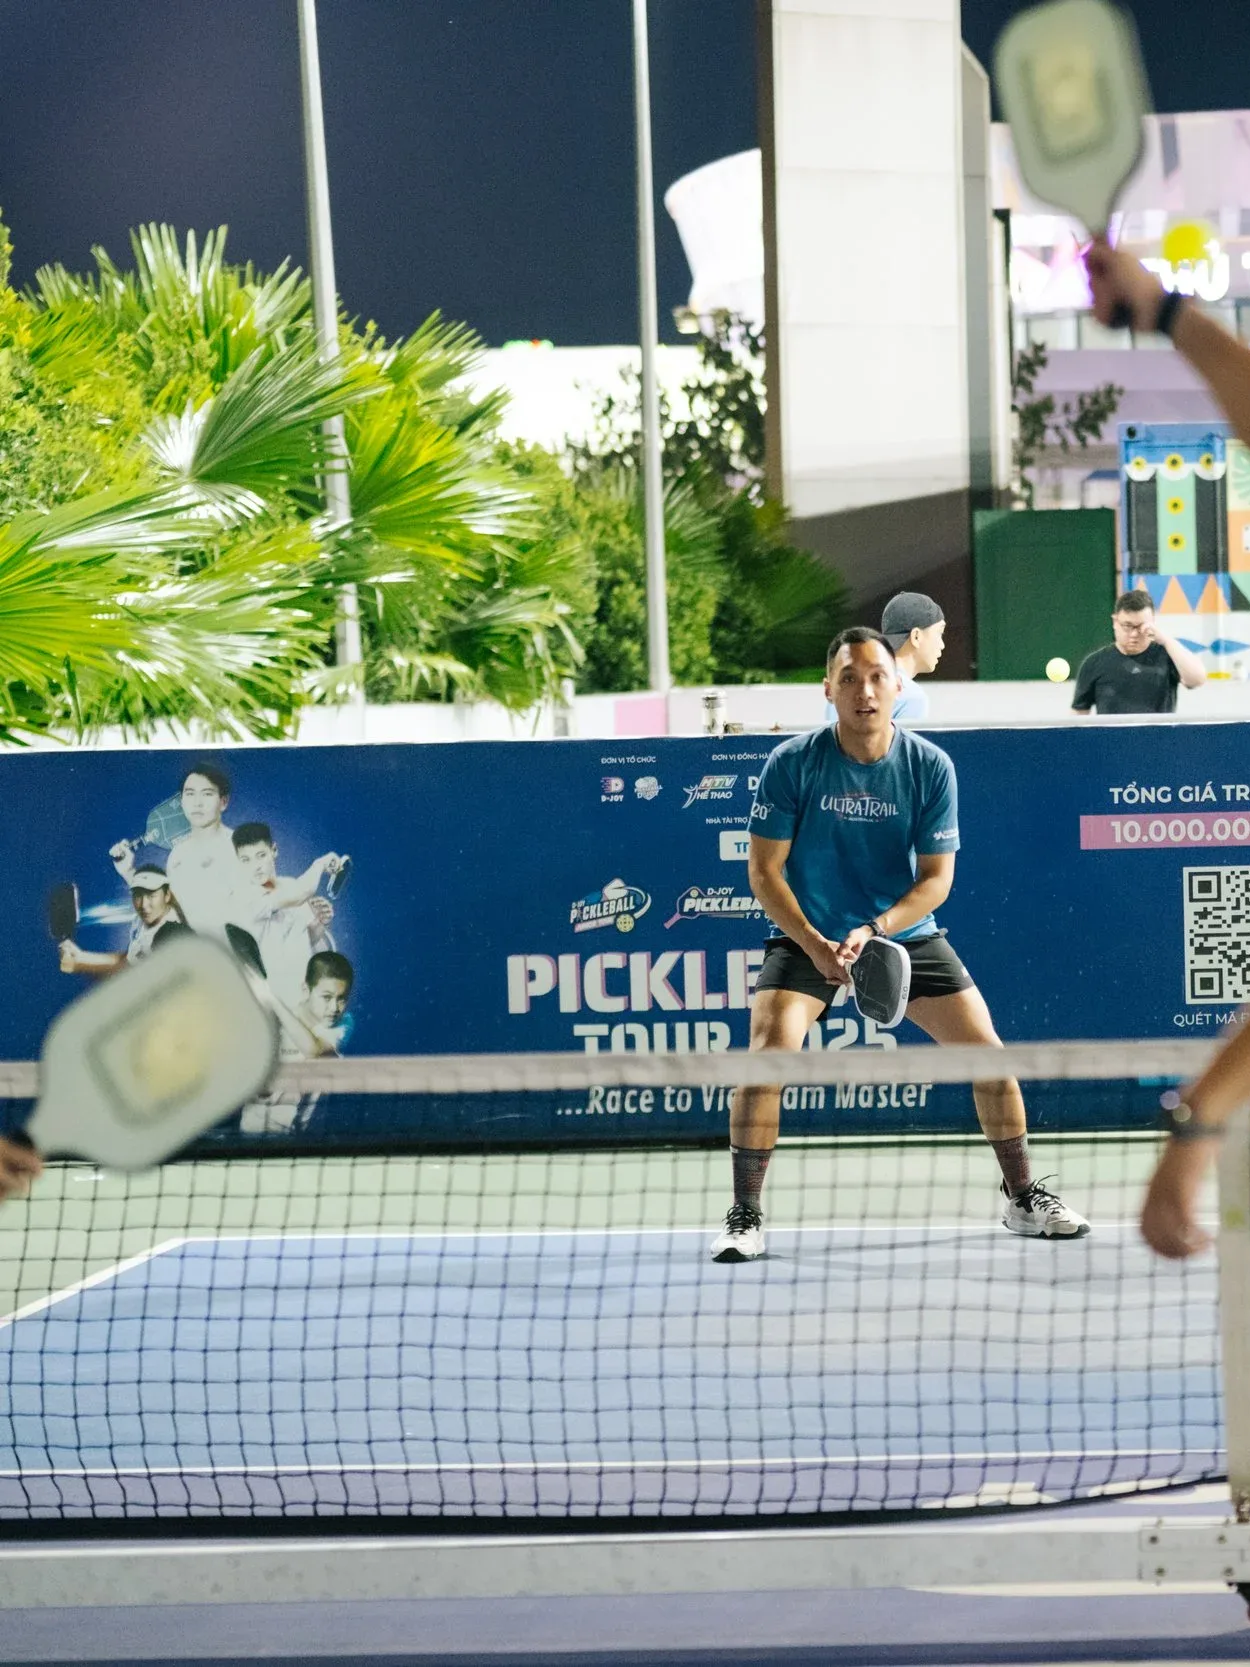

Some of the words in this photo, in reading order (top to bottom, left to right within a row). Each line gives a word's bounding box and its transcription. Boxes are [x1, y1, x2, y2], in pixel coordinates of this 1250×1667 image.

[700, 776, 736, 788] HTV
[601, 794, 624, 802] D-JOY
[1109, 781, 1172, 805] TỔNG
[1178, 781, 1216, 803] GIÁ
[707, 887, 734, 895] D-JOY
[683, 896, 763, 912] PICKLEBA
[1173, 1011, 1212, 1027] QUÉT
[1216, 1010, 1238, 1024] MÃ
[664, 1085, 692, 1113] to
[835, 1081, 933, 1109] Master
